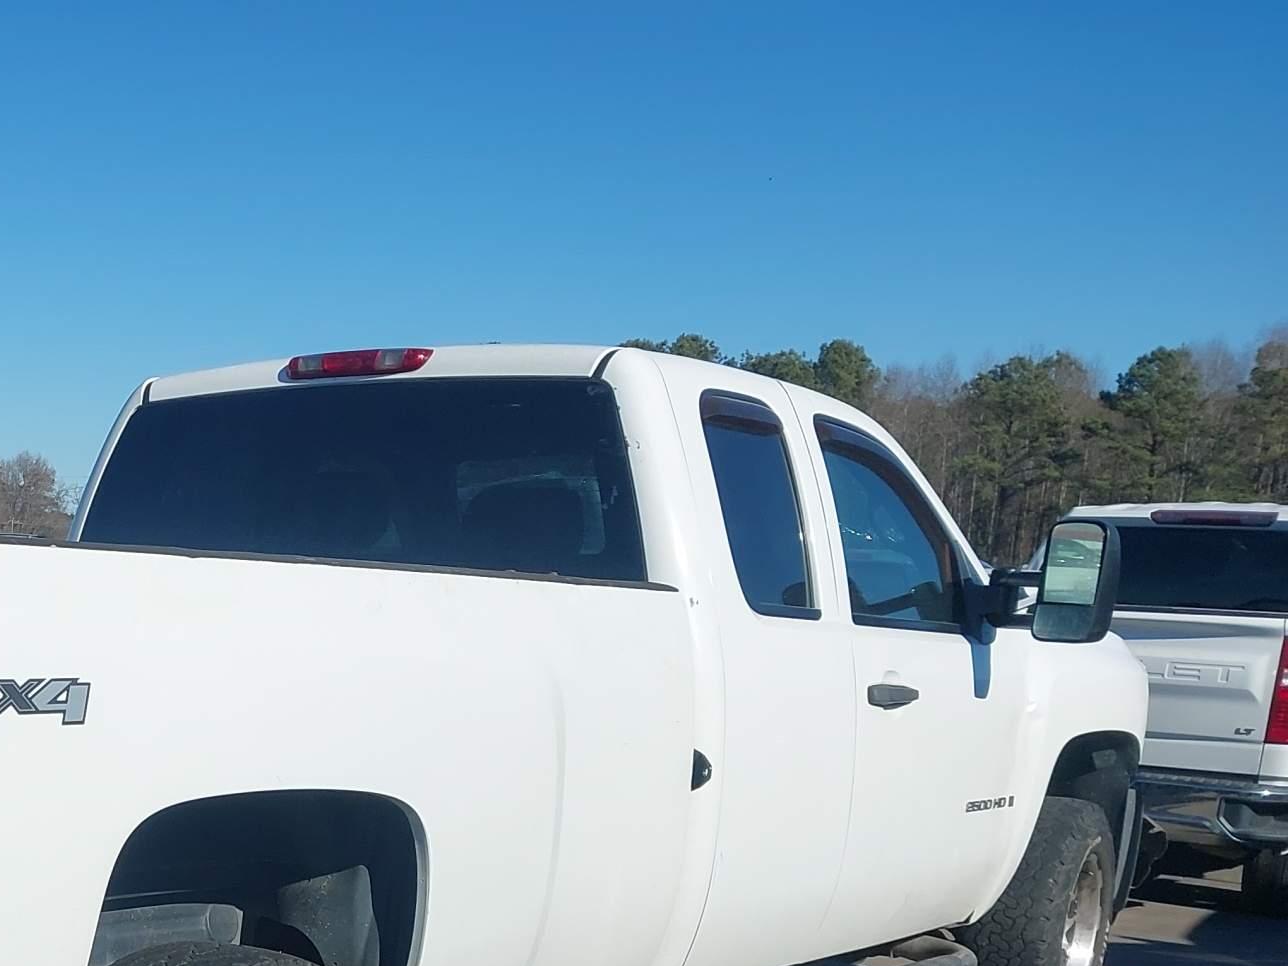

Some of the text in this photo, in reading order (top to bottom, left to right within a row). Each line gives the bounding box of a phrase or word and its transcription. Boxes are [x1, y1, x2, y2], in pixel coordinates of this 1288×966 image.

[1234, 727, 1255, 736] LT
[965, 799, 993, 813] 2500
[992, 796, 1007, 809] HD
